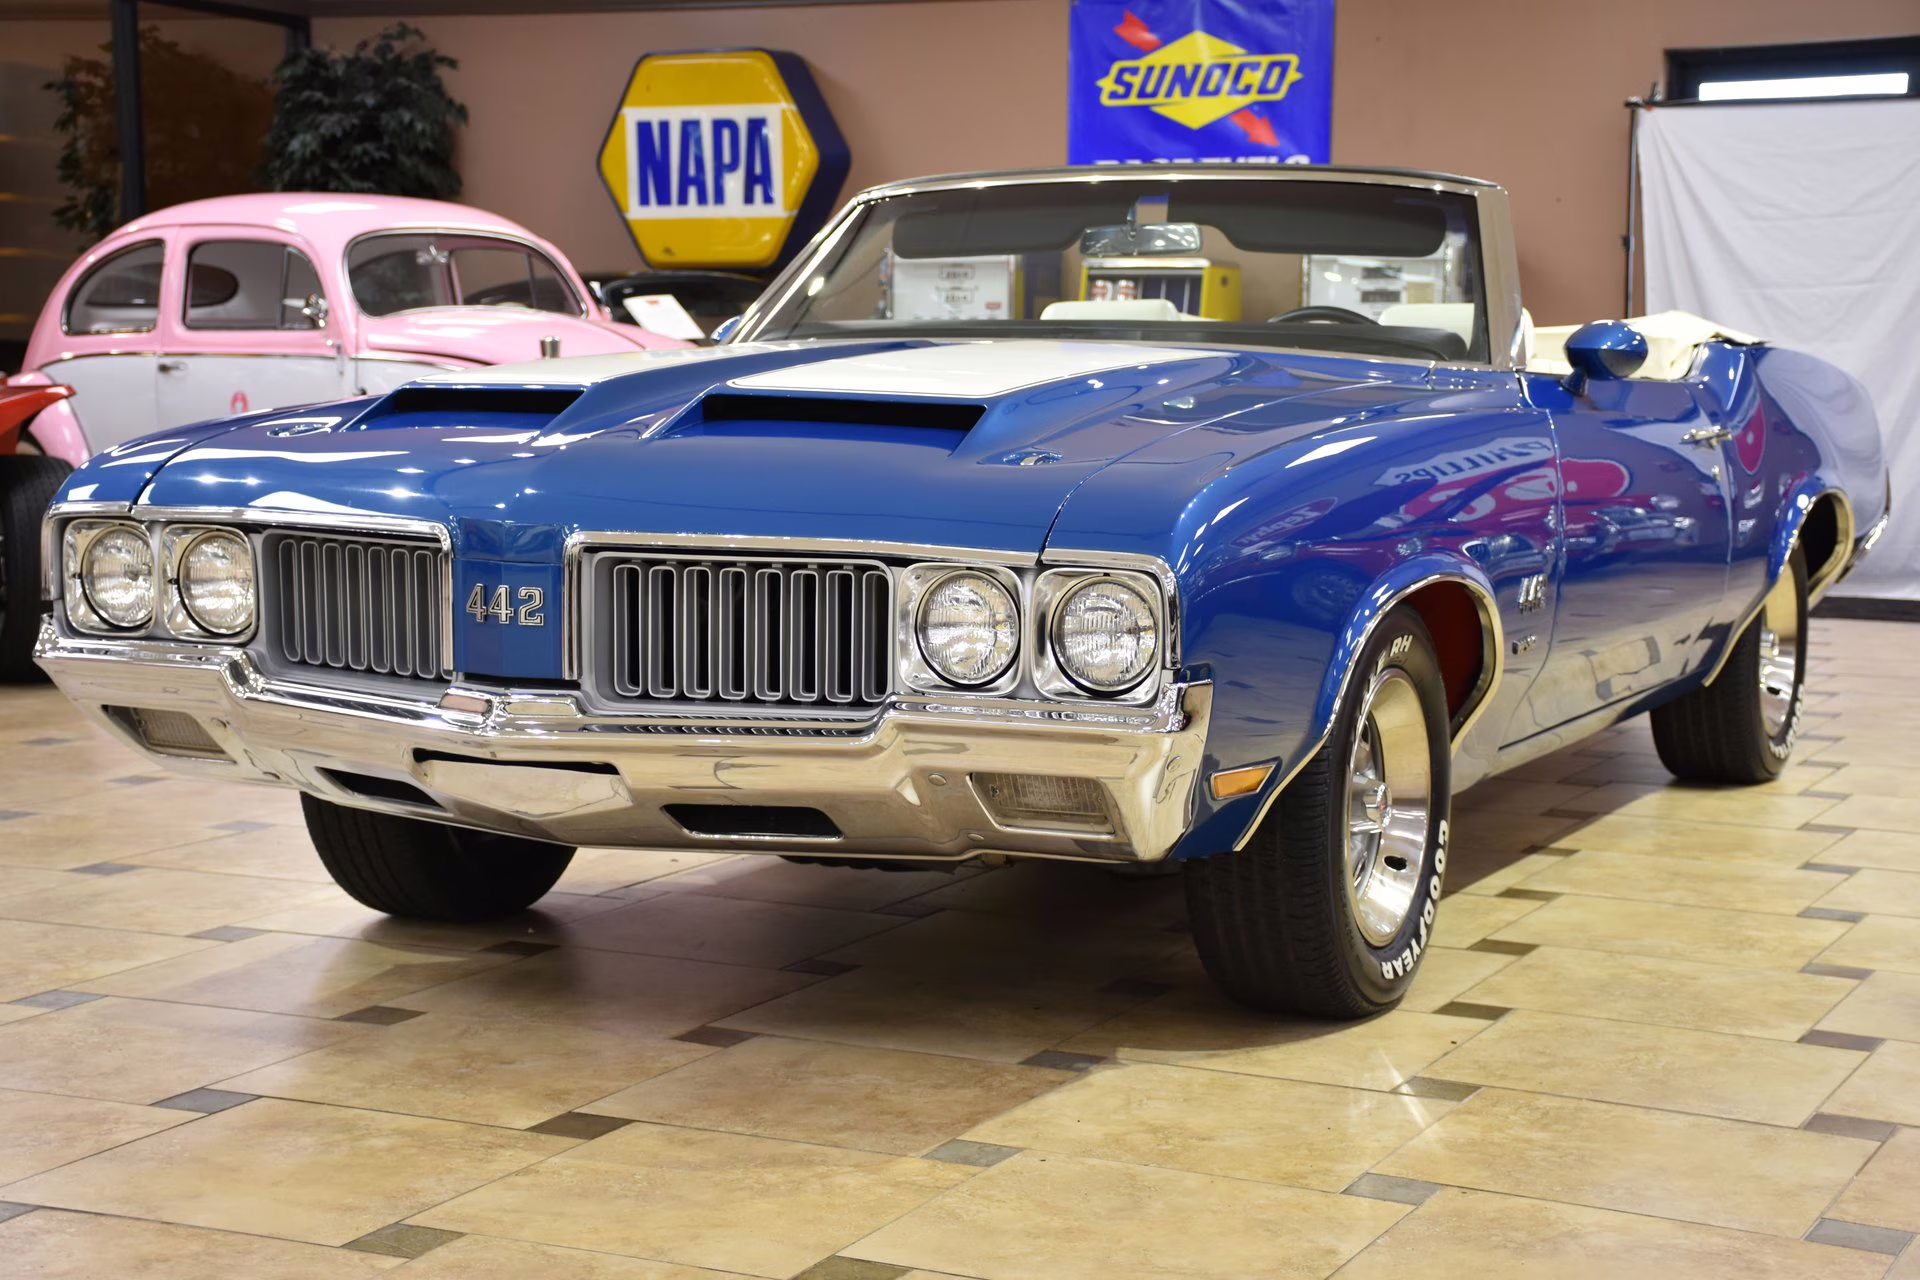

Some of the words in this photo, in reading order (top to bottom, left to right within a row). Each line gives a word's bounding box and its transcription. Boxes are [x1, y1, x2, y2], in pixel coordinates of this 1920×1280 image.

[1107, 60, 1291, 100] SUNOCO
[636, 118, 774, 206] NAPA
[466, 583, 544, 626] 442
[1382, 819, 1449, 980] GOODYEAR
